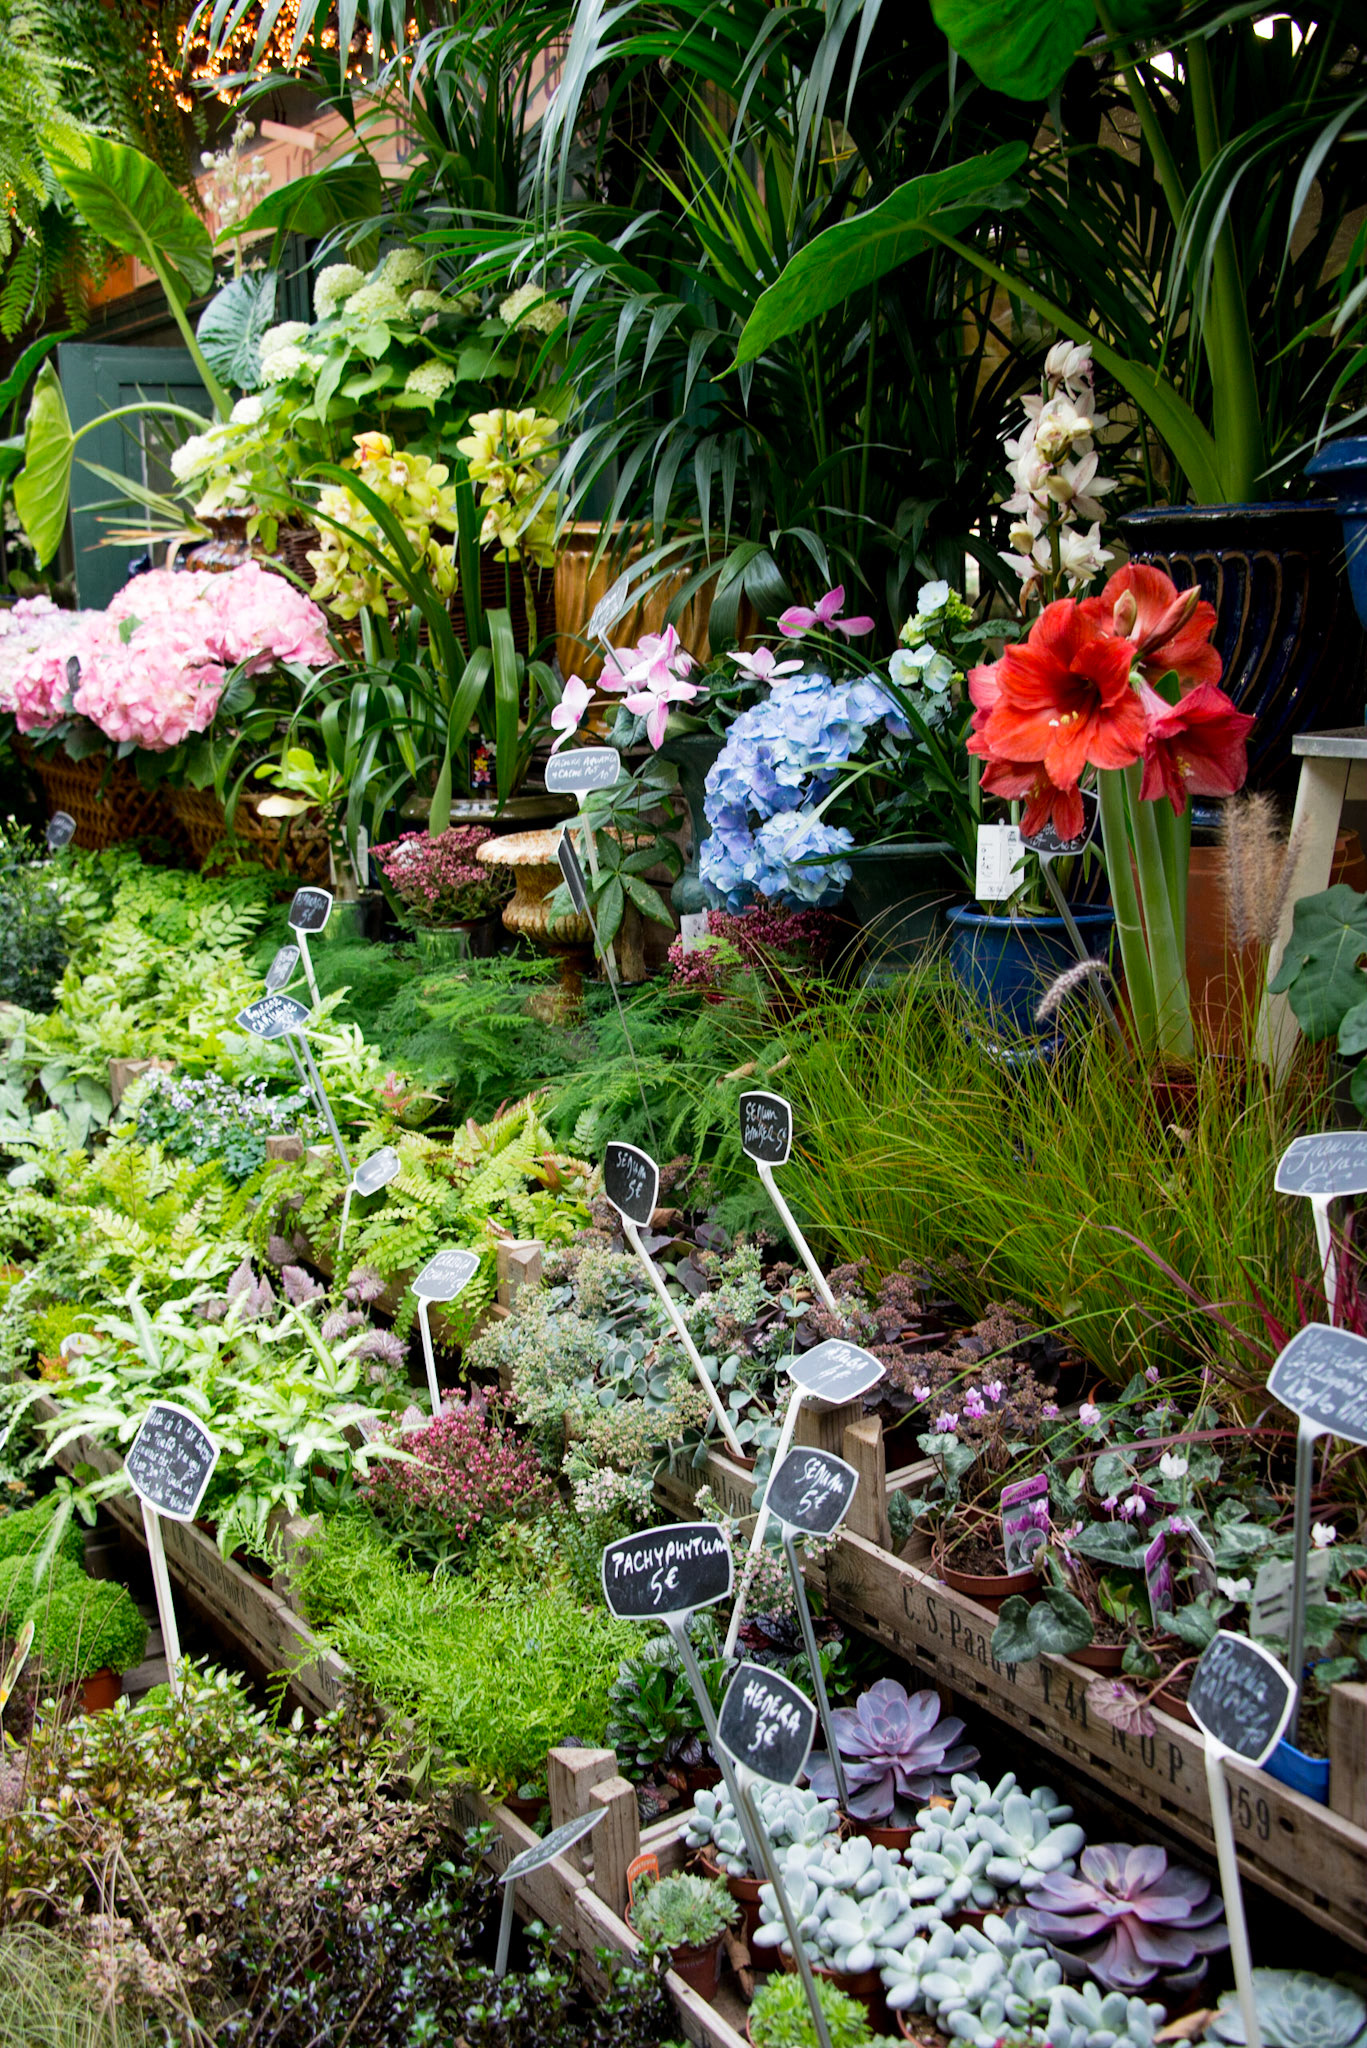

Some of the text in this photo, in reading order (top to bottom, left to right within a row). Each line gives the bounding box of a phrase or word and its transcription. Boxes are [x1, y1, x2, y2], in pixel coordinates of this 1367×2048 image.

[625, 1179, 643, 1202] 5€
[796, 1489, 829, 1515] 5€
[611, 1536, 728, 1579] PACHYPHYTUM
[650, 1566, 680, 1606] 5€
[742, 1680, 801, 1737] HEDERA
[747, 1721, 780, 1752] 3€
